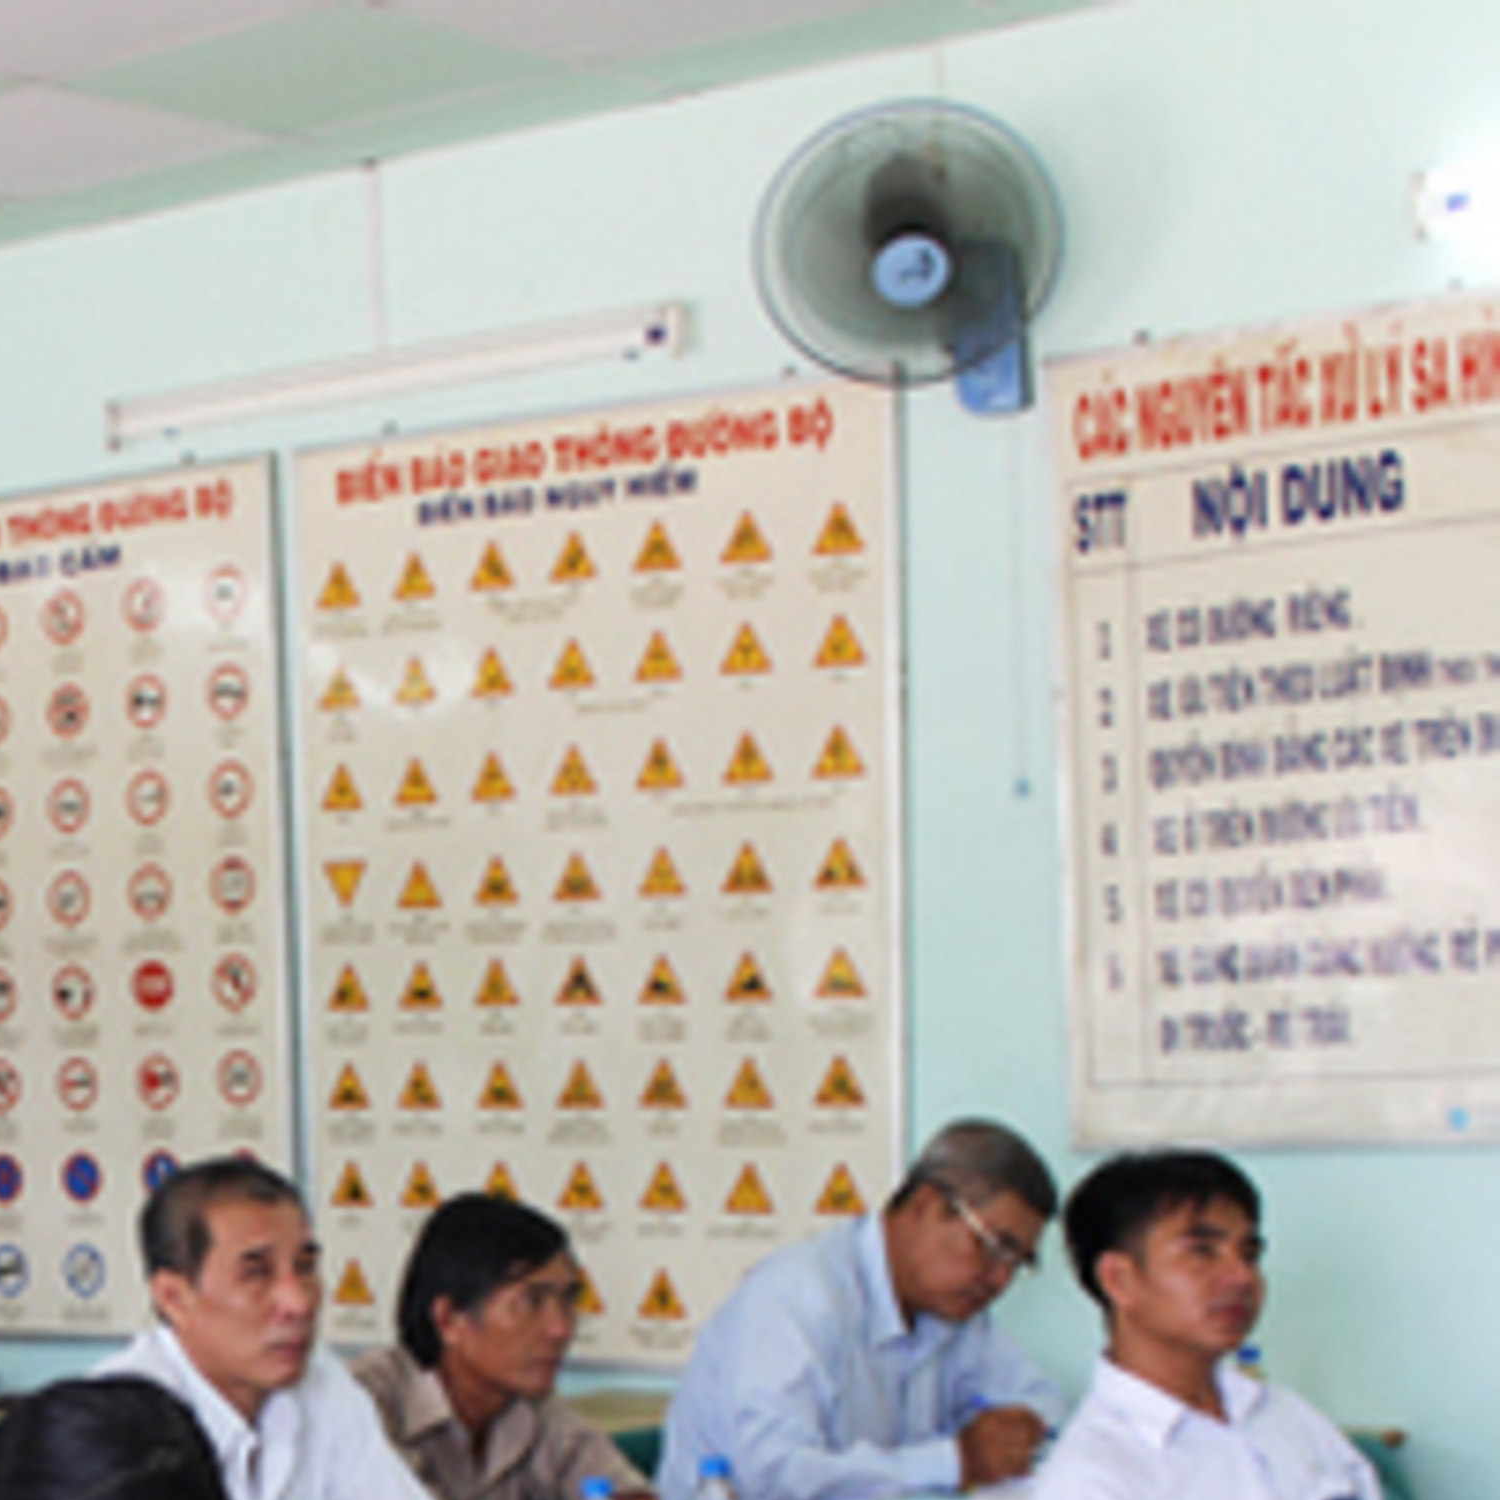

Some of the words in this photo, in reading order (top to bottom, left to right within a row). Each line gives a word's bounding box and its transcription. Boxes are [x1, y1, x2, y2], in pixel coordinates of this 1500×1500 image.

[1073, 490, 1128, 555] STT
[1191, 462, 1270, 540] NỘI
[1280, 449, 1405, 526] DUNG
